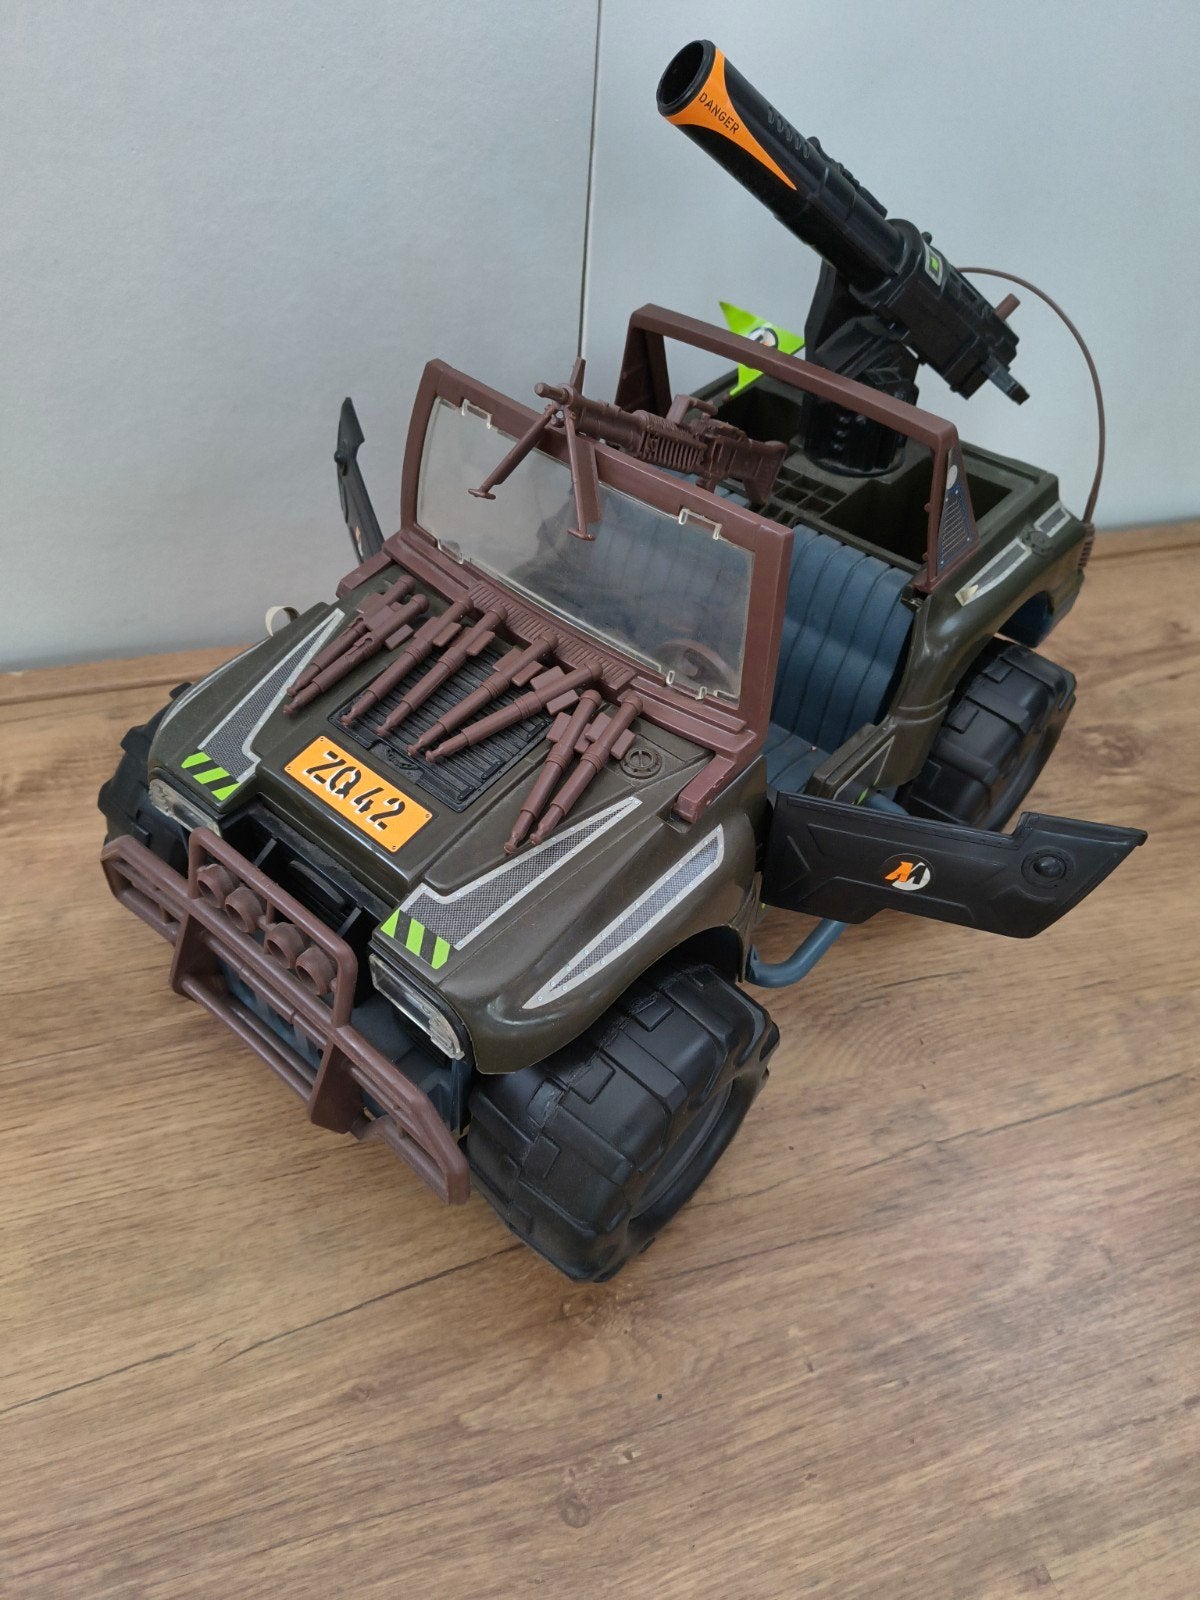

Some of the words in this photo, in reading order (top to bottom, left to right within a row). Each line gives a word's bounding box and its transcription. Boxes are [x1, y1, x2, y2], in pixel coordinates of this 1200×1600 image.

[698, 91, 740, 134] DANGER
[302, 750, 362, 800] ZQ
[351, 786, 406, 832] 42
